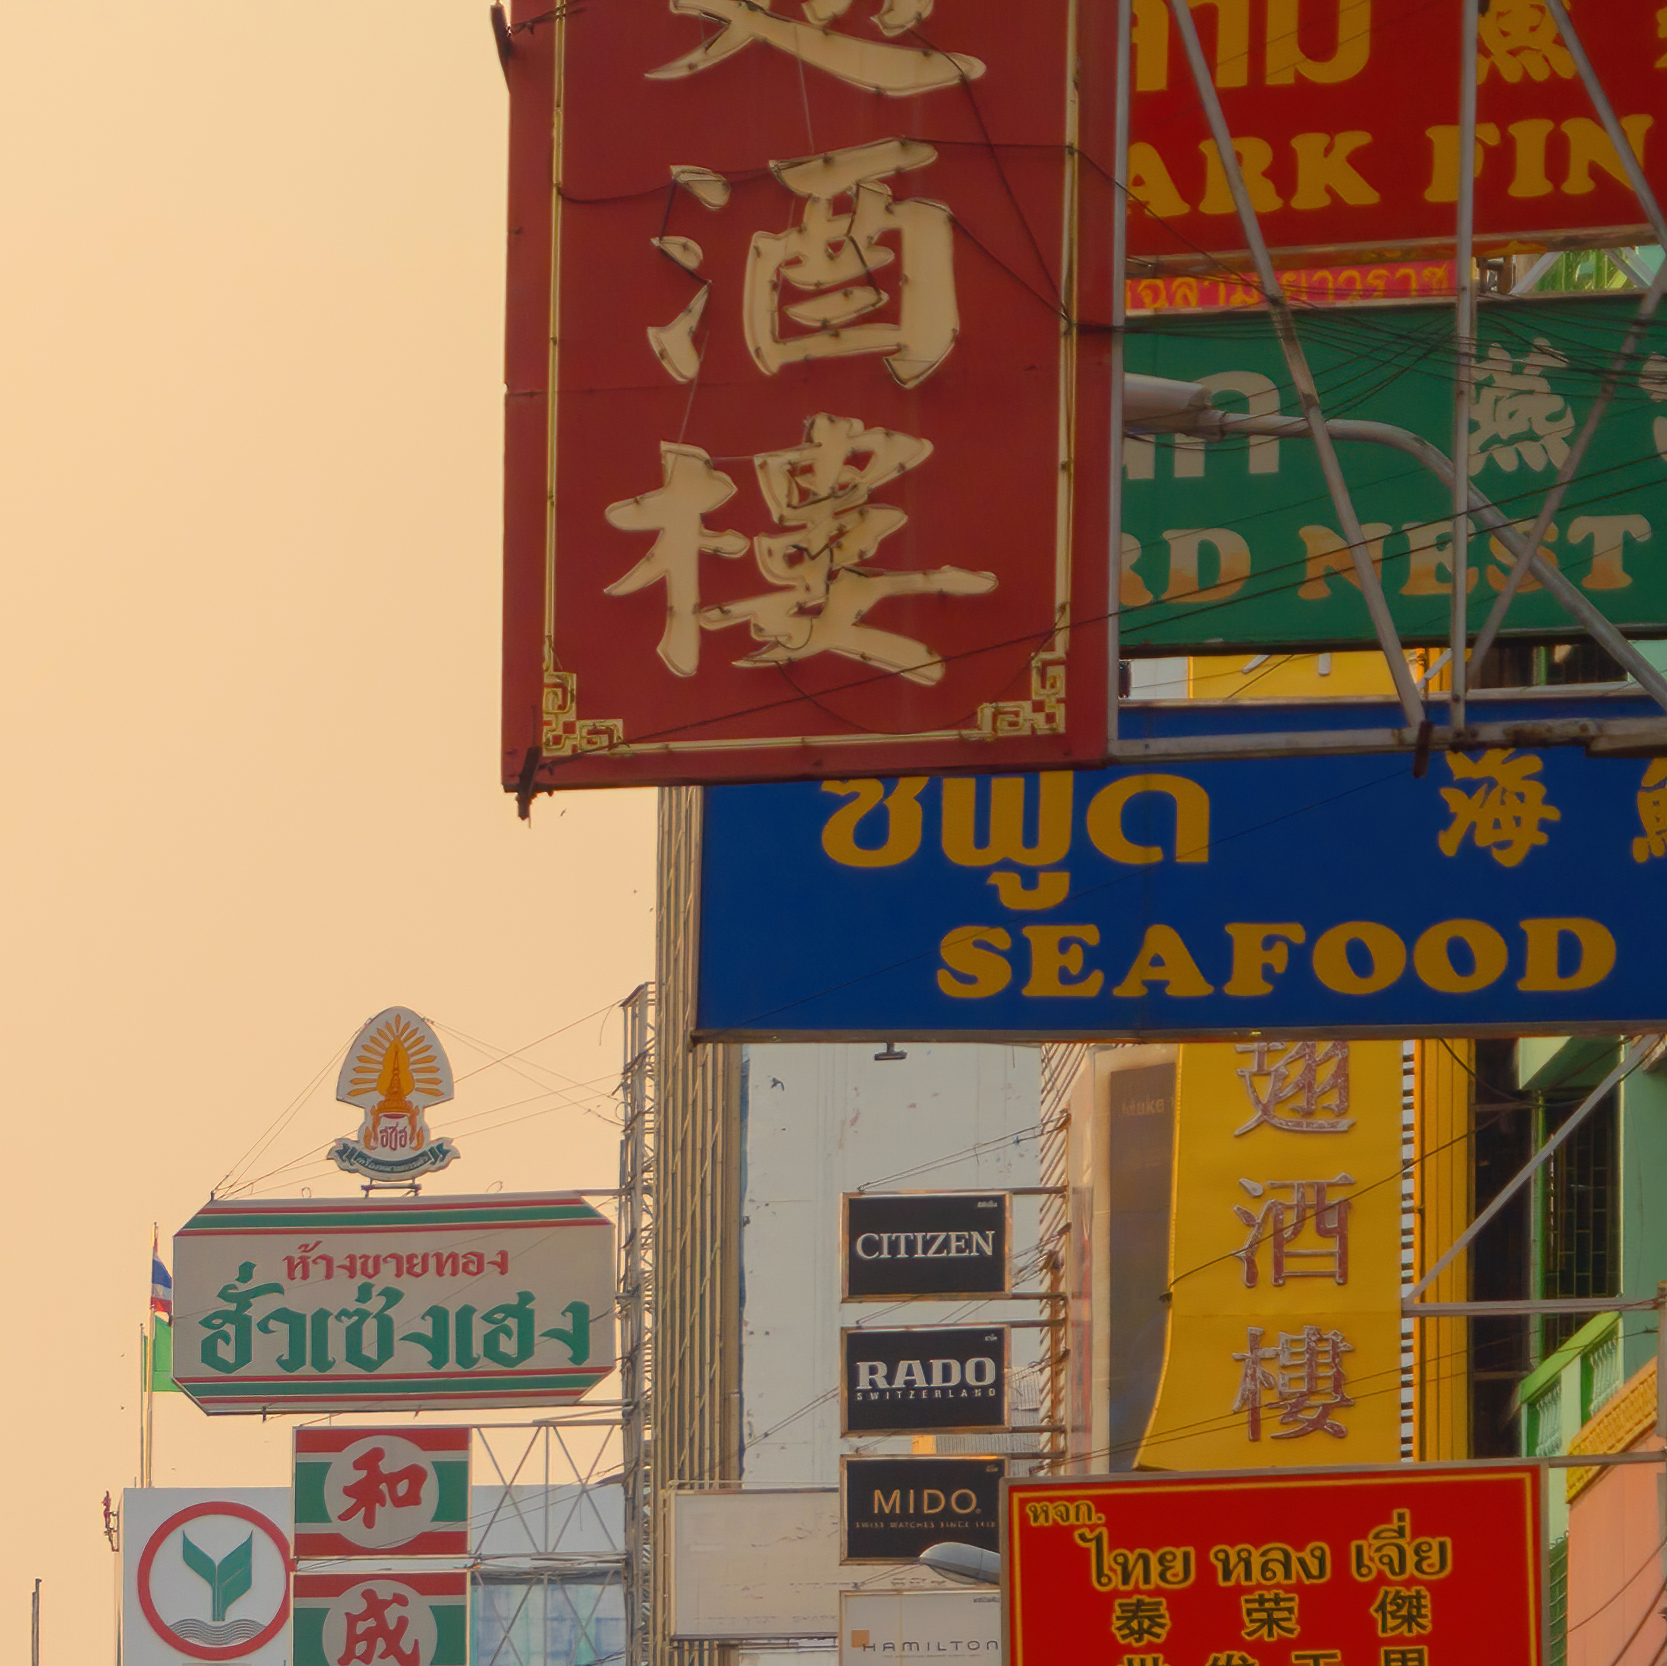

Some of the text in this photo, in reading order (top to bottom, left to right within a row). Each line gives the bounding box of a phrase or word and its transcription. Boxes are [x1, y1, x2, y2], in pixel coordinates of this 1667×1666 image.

[1124, 130, 1380, 217] ARK
[937, 917, 1617, 999] SEAFOOD
[282, 1240, 510, 1281] ห้างขายทอง
[856, 1230, 995, 1259] CITIZEN
[857, 1356, 997, 1389] RADO
[856, 1388, 997, 1401] SWITZERLAND
[874, 1488, 976, 1514] MIDO
[1075, 1529, 1194, 1592] ไทย
[1209, 1539, 1331, 1585] หลง
[862, 1639, 1000, 1653] HAMILTON
